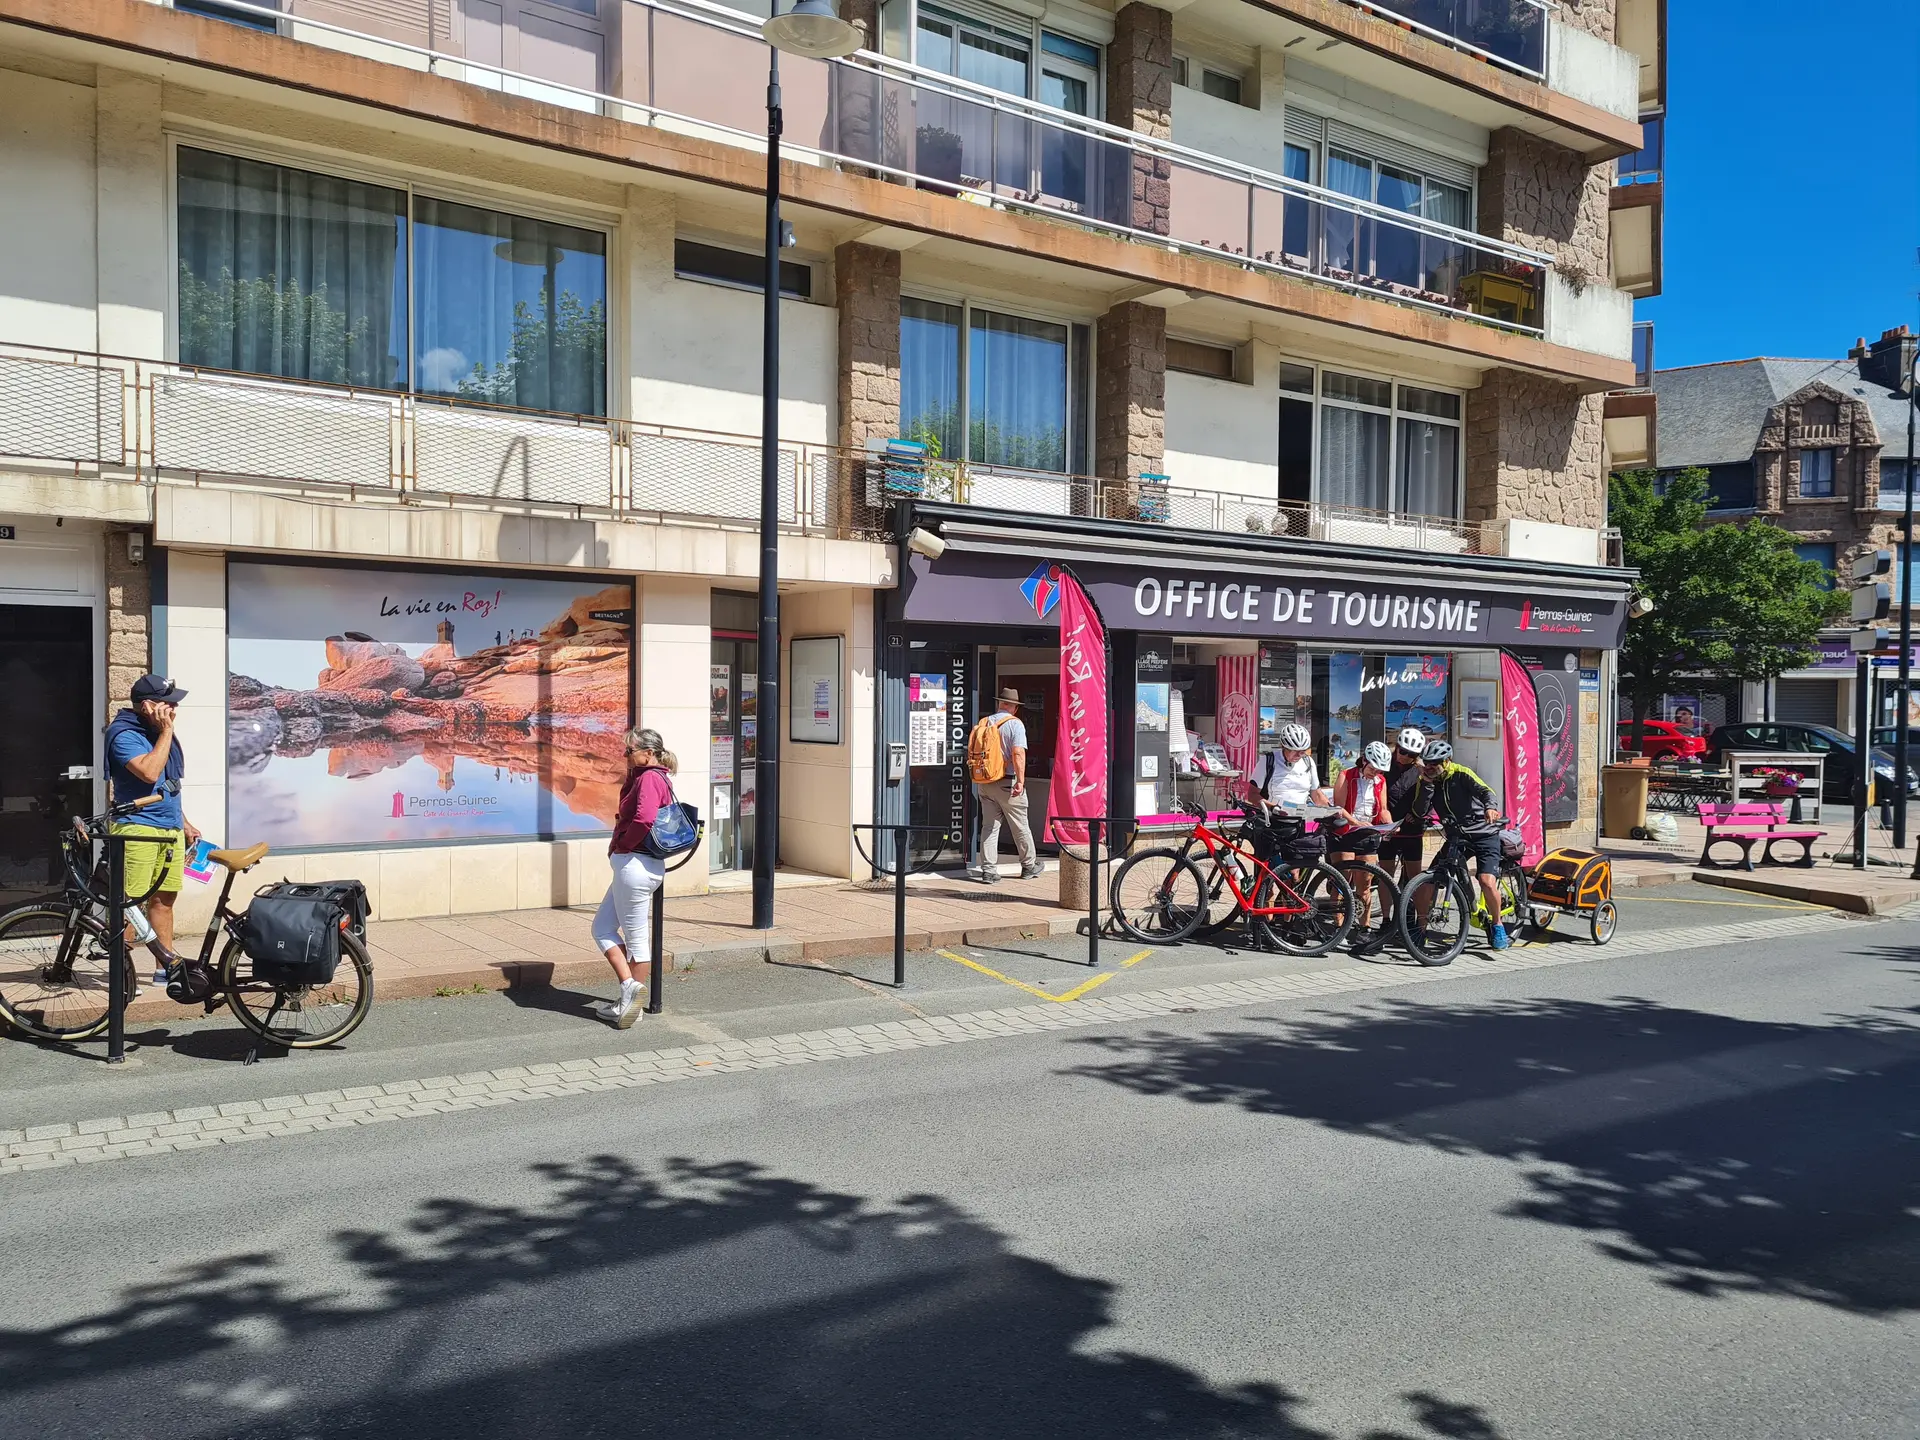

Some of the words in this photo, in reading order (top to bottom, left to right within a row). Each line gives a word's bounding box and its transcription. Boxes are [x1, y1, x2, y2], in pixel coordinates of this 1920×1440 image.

[380, 596, 400, 616] La
[406, 599, 431, 615] vie
[436, 601, 457, 612] en
[462, 590, 501, 618] Roz!
[1134, 577, 1261, 621] OFFICE
[1272, 587, 1316, 623] DE
[1328, 590, 1481, 632] TOURISME
[1532, 606, 1592, 622] Perros-Guirec
[891, 637, 899, 645] 21
[1360, 666, 1377, 692] La
[1377, 667, 1398, 689] vie
[1401, 668, 1418, 682] en
[952, 658, 965, 749] TOURISME
[1561, 704, 1572, 740] welcome
[952, 756, 963, 776] DE
[409, 795, 498, 808] Perros-Guirec
[952, 784, 963, 843] OFFICE
